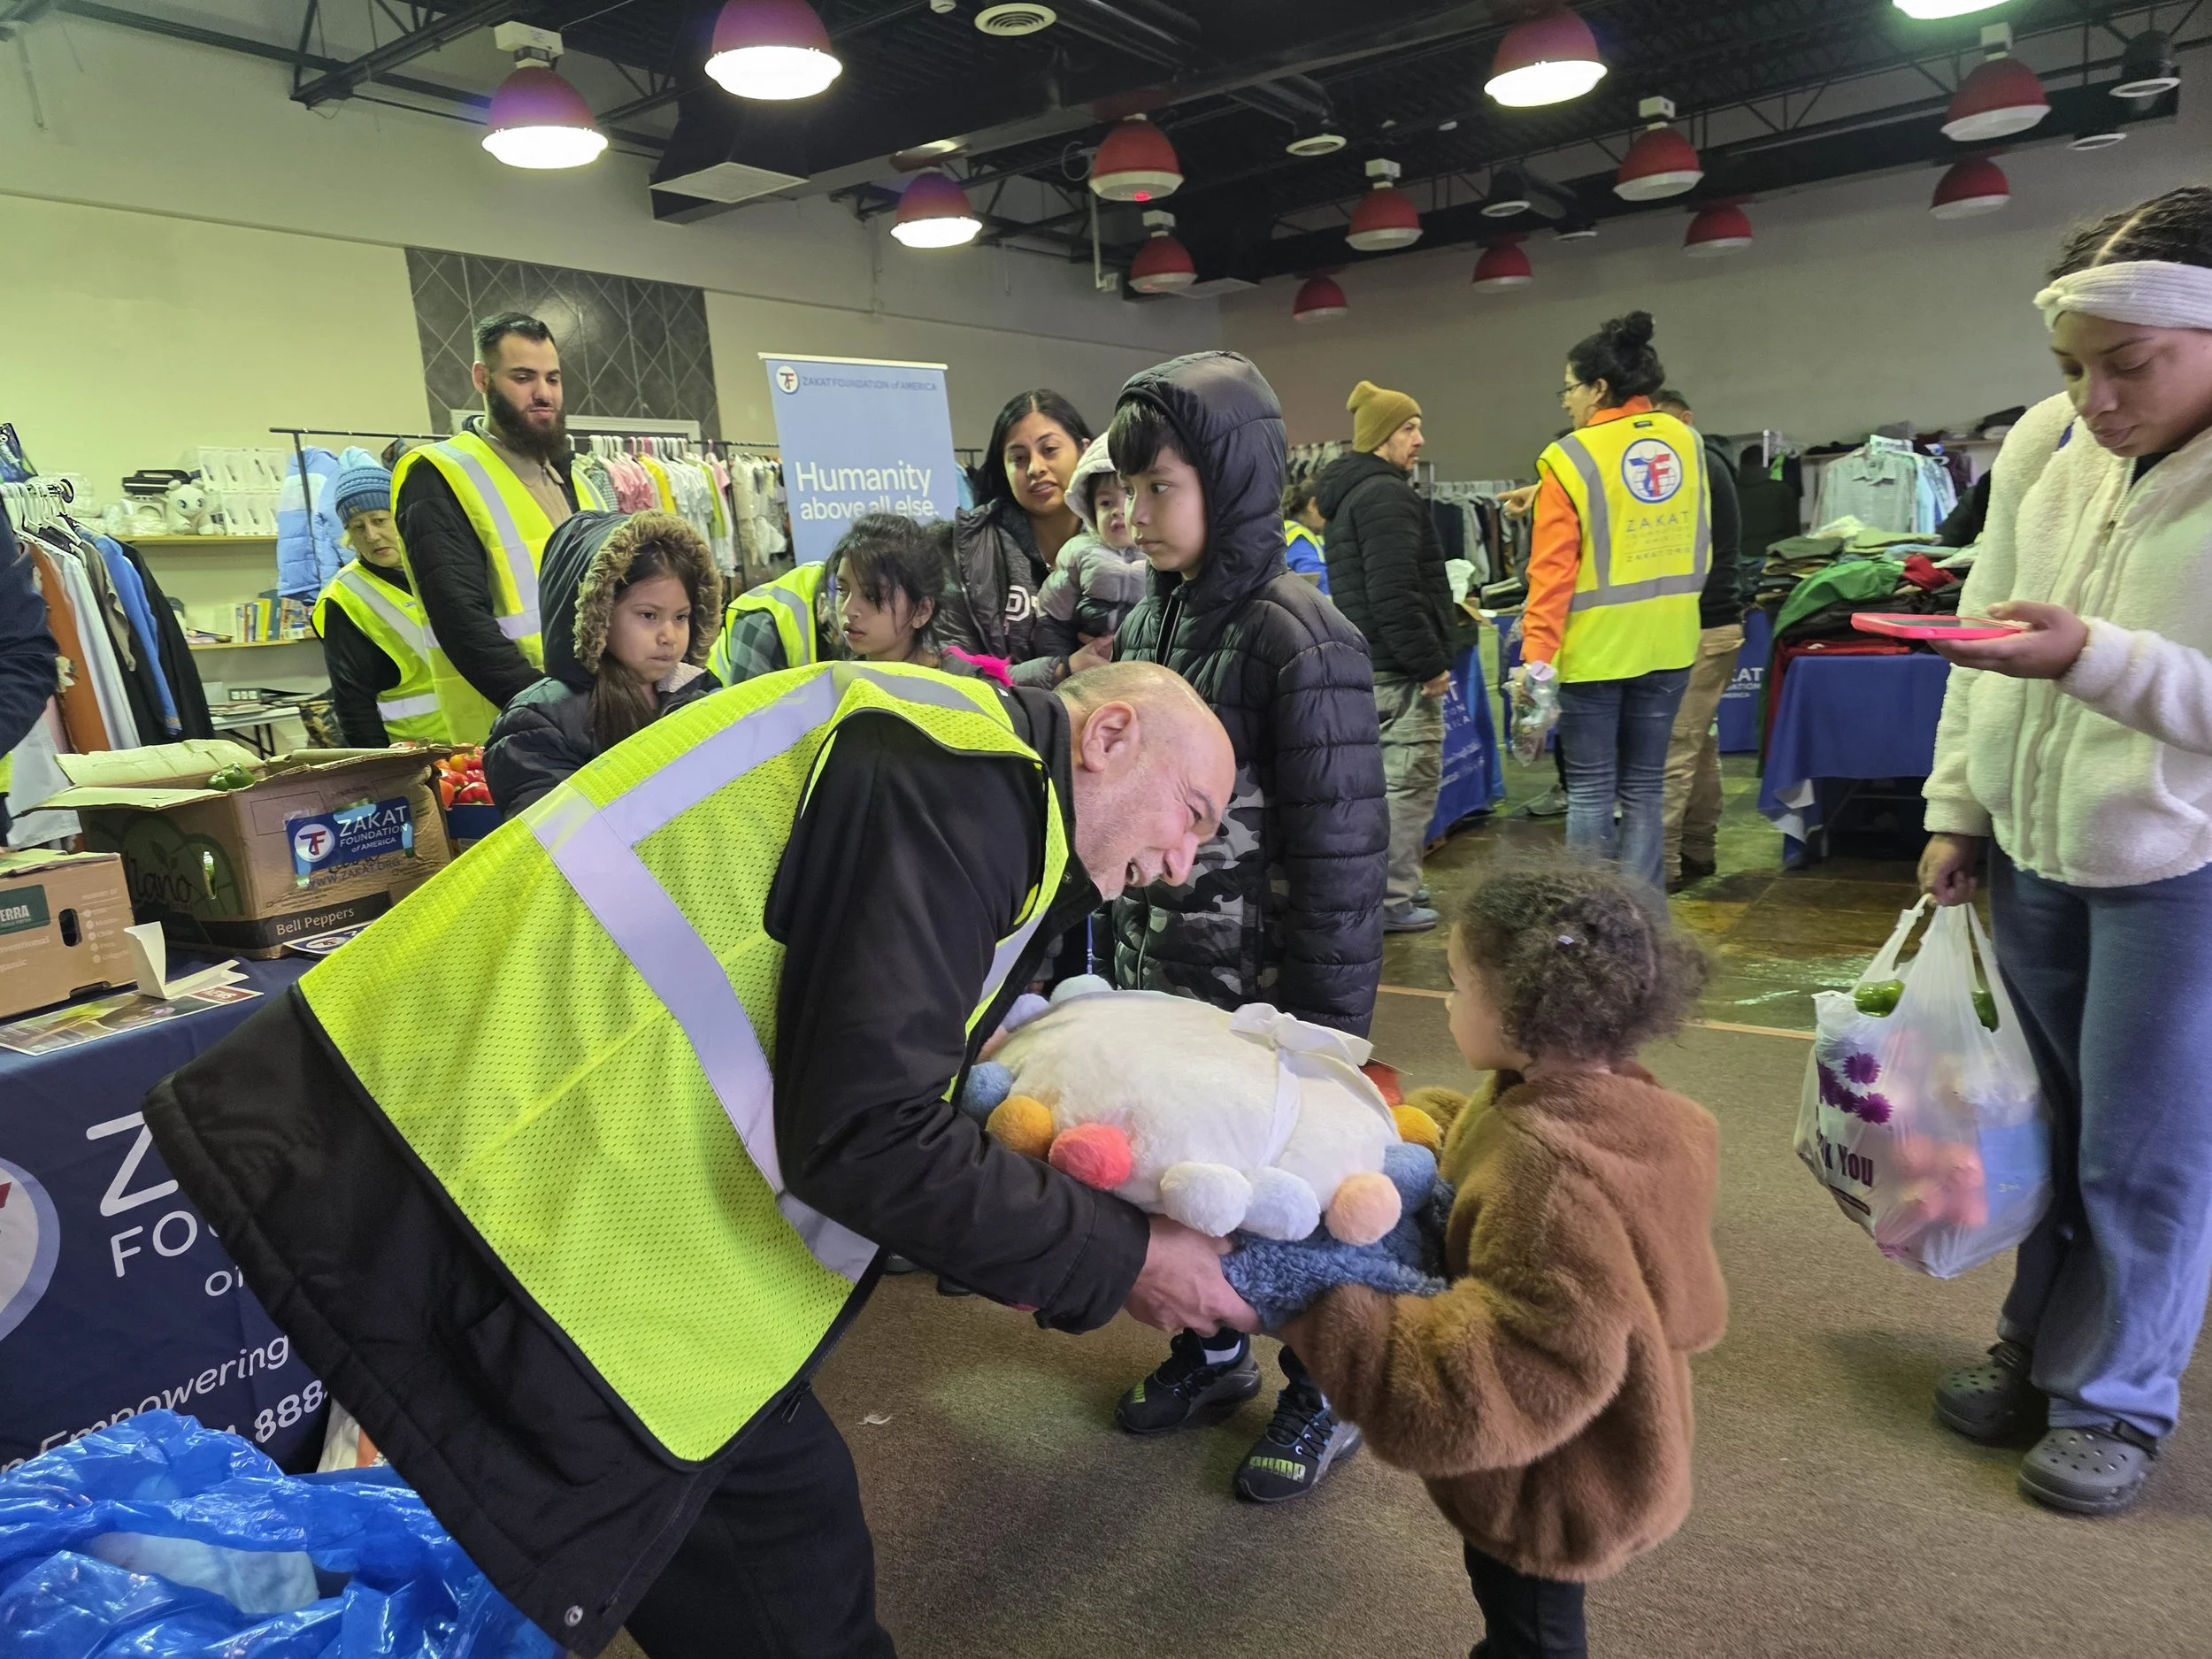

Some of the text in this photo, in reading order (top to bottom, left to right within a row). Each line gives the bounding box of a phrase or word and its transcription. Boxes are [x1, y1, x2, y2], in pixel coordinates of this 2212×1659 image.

[802, 377, 938, 391] ZAKAT FOUNDATION of AMERICA
[795, 459, 932, 497] Humanity
[800, 495, 940, 520] above all else.
[1626, 511, 1689, 534] ZAKAT
[337, 805, 407, 837] ZAKAT
[340, 822, 408, 848] FOUNDATION
[361, 836, 396, 850] AMERICA
[276, 908, 355, 936] Bell Peppers
[111, 1210, 219, 1279] FO
[1248, 1455, 1307, 1484] PUMA
